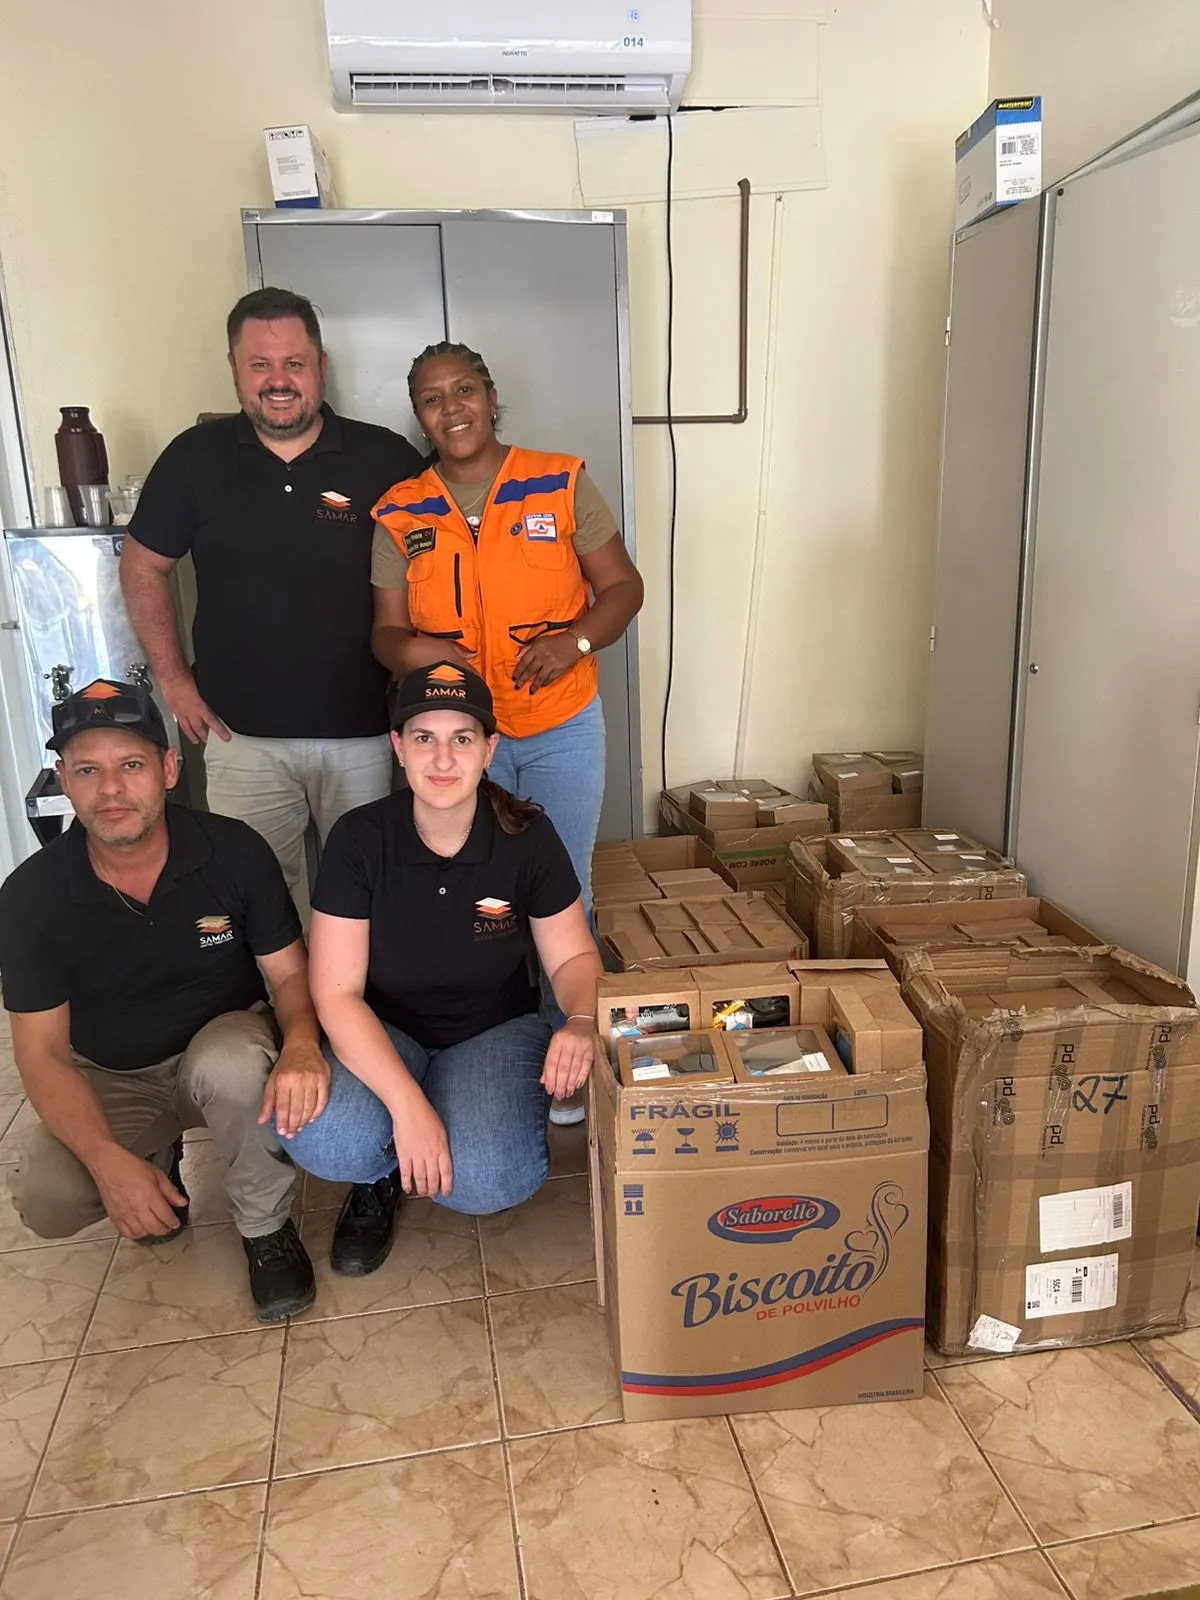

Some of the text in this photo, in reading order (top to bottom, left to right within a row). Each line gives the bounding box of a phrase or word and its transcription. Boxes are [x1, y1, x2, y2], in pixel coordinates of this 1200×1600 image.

[623, 37, 644, 47] 014
[316, 509, 358, 523] SAMAR
[425, 688, 467, 699] SAMAR
[750, 858, 777, 868] DOBRE
[200, 930, 233, 945] SAMAR
[1073, 1074, 1129, 1114] 27
[630, 1100, 741, 1120] FRÁGIL
[724, 1199, 816, 1228] Saborelle
[671, 1251, 875, 1329] Biscoito
[756, 1294, 861, 1321] DE POLVILHO
